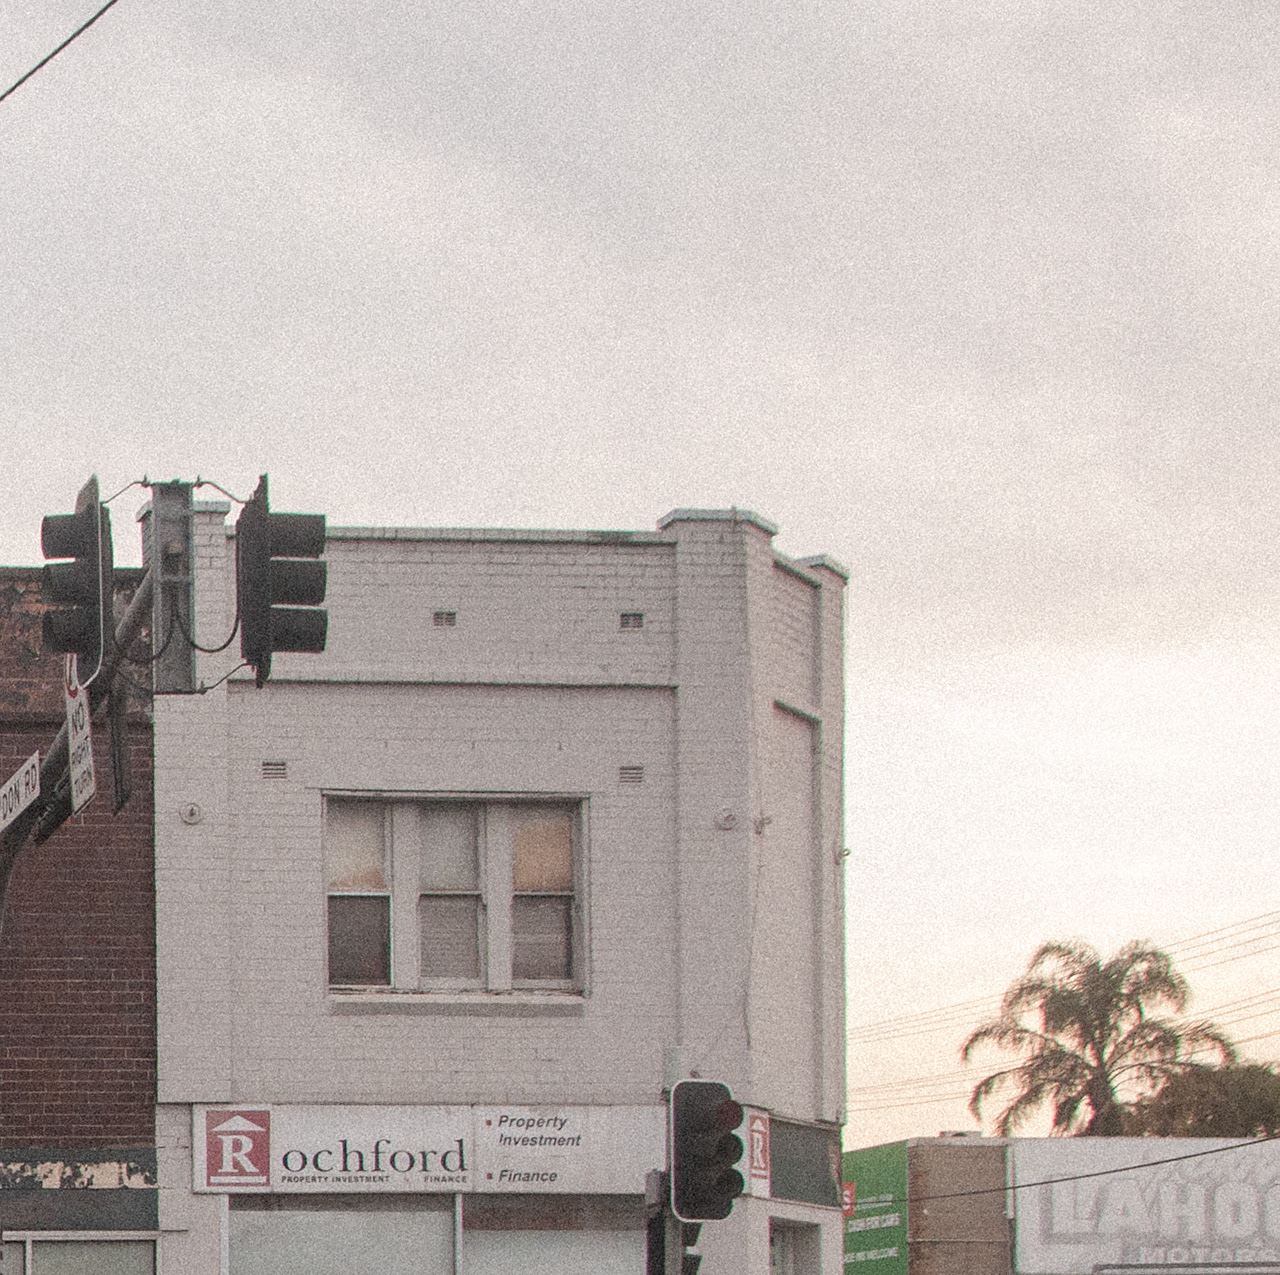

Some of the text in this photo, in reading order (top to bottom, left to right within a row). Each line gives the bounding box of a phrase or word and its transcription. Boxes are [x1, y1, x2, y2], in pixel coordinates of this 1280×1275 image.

[24, 763, 37, 799] RD
[497, 1115, 568, 1131] Property
[499, 1133, 582, 1146] Investment
[281, 1175, 329, 1183] PROPERTY
[331, 1175, 390, 1183] INVESTMENT
[423, 1175, 468, 1183] FINANCE
[498, 1169, 558, 1182] Finance
